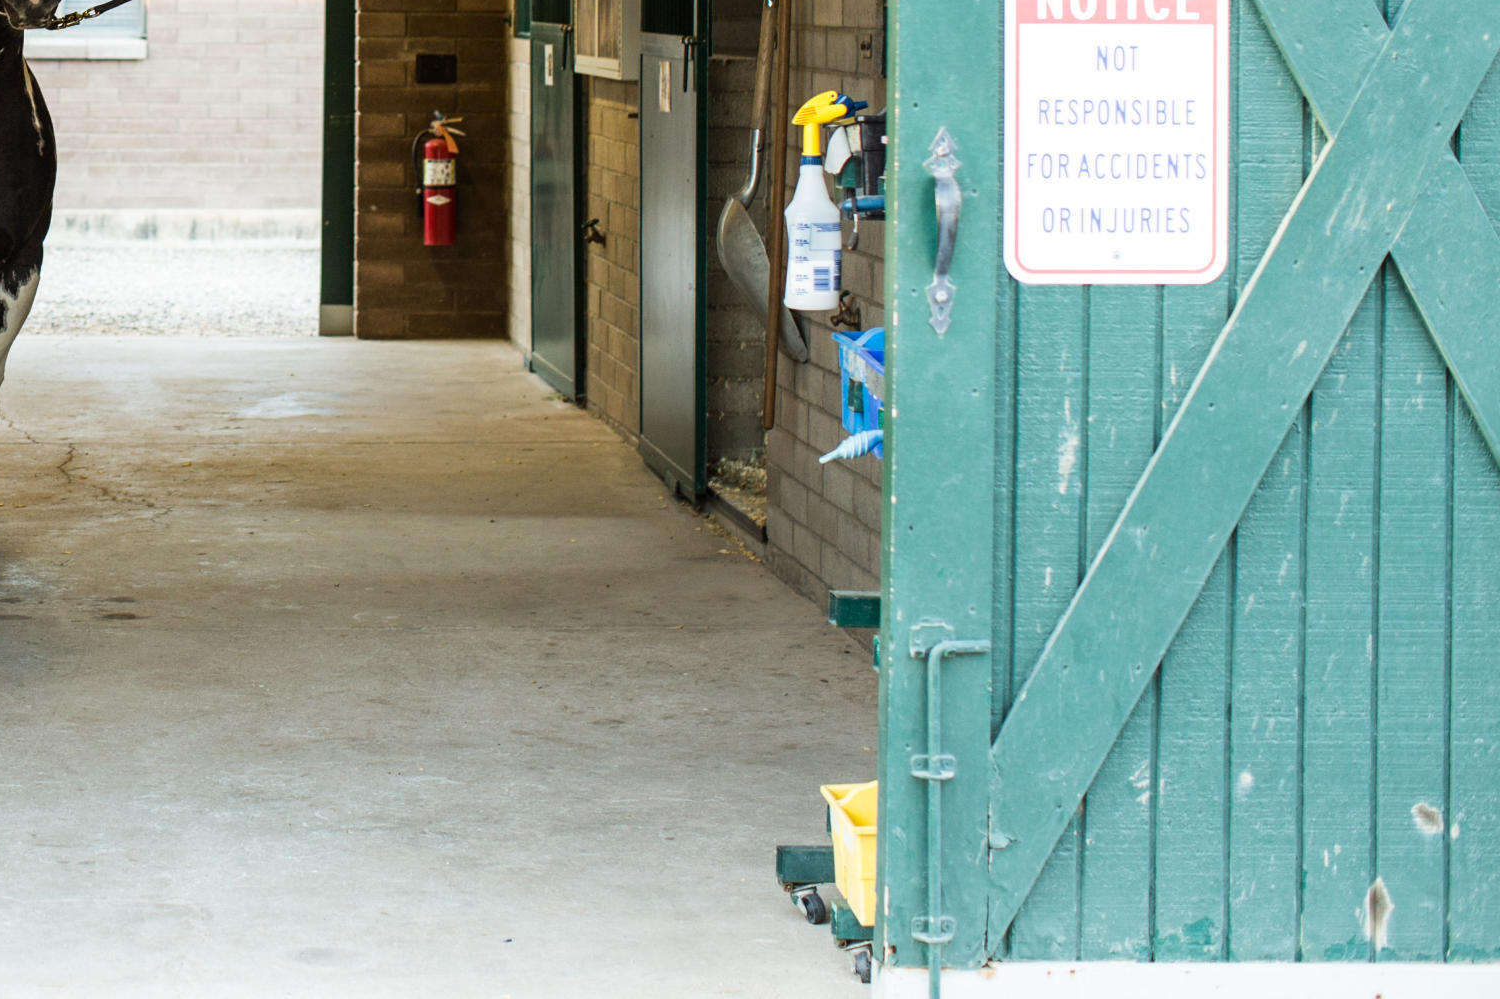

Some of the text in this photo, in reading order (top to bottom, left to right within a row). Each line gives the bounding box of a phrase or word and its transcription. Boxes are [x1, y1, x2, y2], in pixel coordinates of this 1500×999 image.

[1096, 45, 1140, 72] NOT
[1038, 99, 1196, 126] RESPONSIBLE
[1027, 153, 1207, 180] FOR ACCIDENTS
[1042, 207, 1190, 234] OR INJURIES
